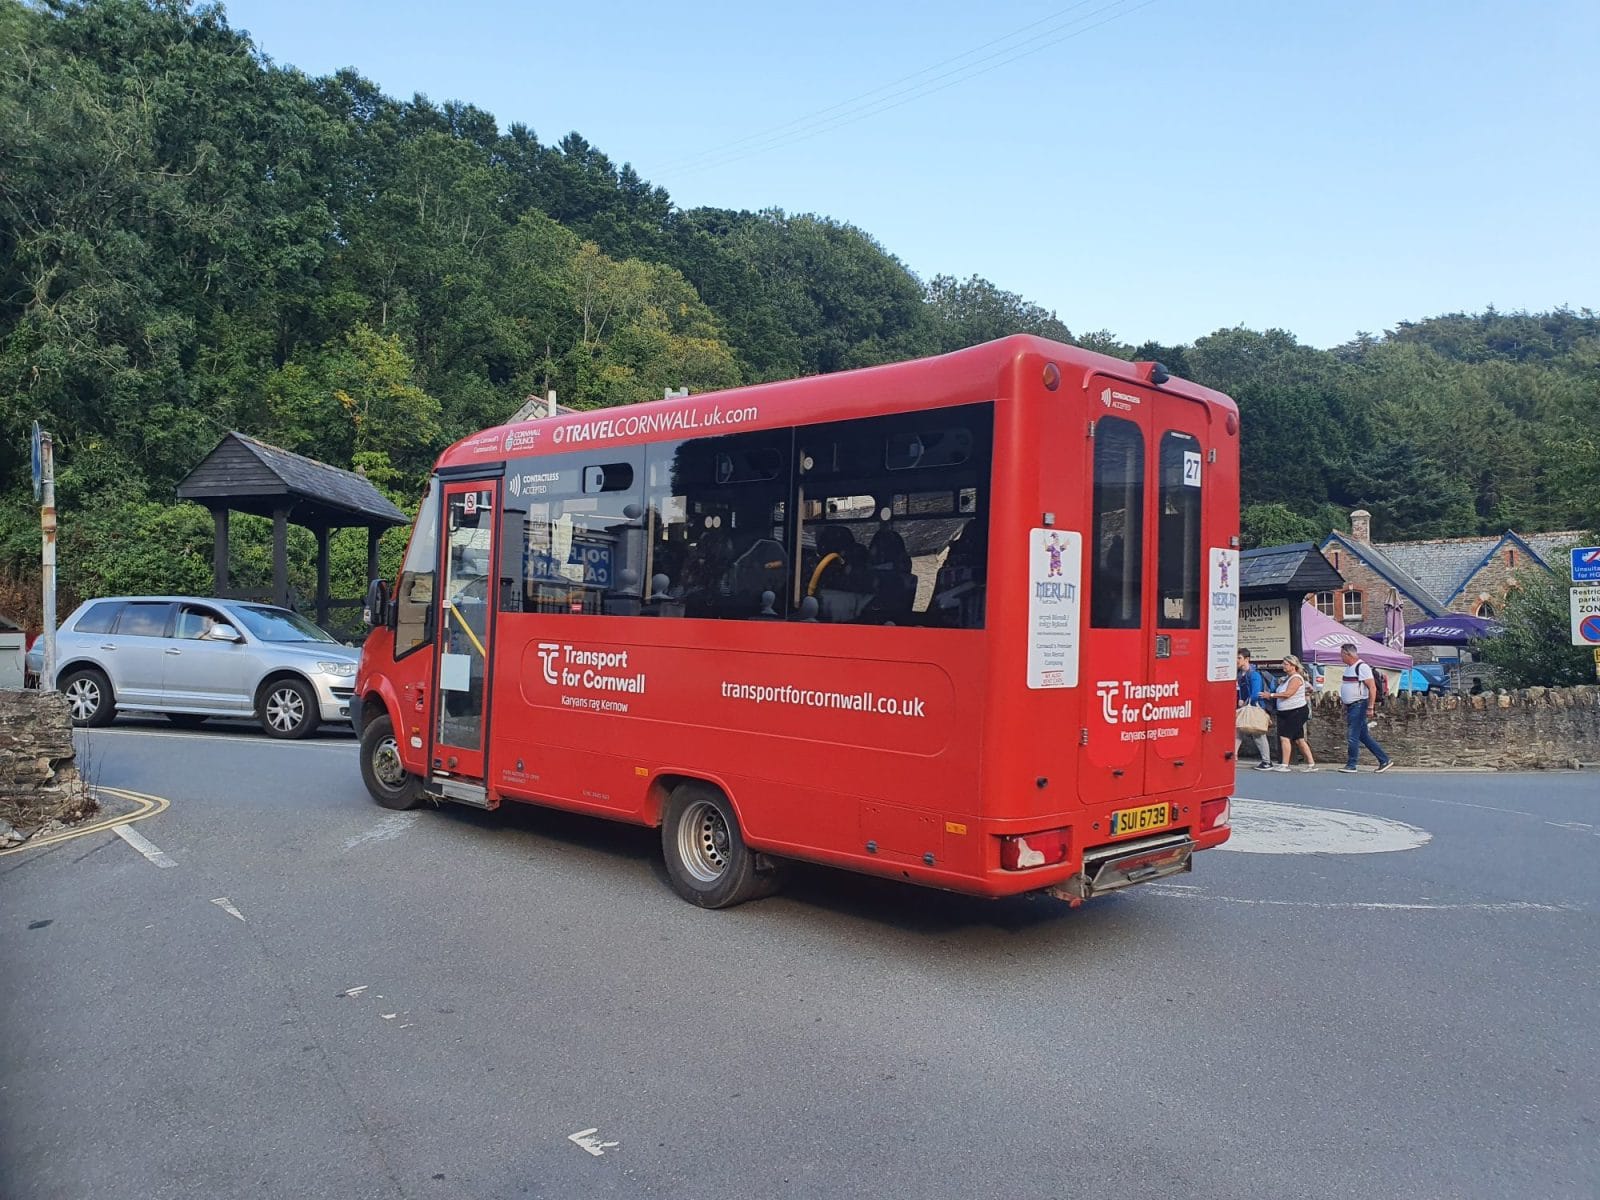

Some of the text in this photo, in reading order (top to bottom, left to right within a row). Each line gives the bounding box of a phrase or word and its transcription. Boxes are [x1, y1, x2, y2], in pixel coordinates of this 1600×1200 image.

[523, 472, 560, 484] CONTACTLESS
[1185, 459, 1200, 480] 27
[522, 485, 547, 495] ACCEPTED
[1035, 582, 1076, 604] MERLIN
[1409, 626, 1465, 636] TRIBUTE
[563, 645, 628, 671] Transport
[562, 667, 645, 694] for Cornwall
[1123, 681, 1179, 701] Transport
[561, 695, 629, 713] Karyans rag Kernow
[721, 681, 925, 717] transportforcornwall.co.uk
[1122, 700, 1192, 723] for Cornwall
[1147, 730, 1157, 740] rag
[1157, 727, 1179, 738] Kernow
[1121, 806, 1166, 831] SUI 6739
